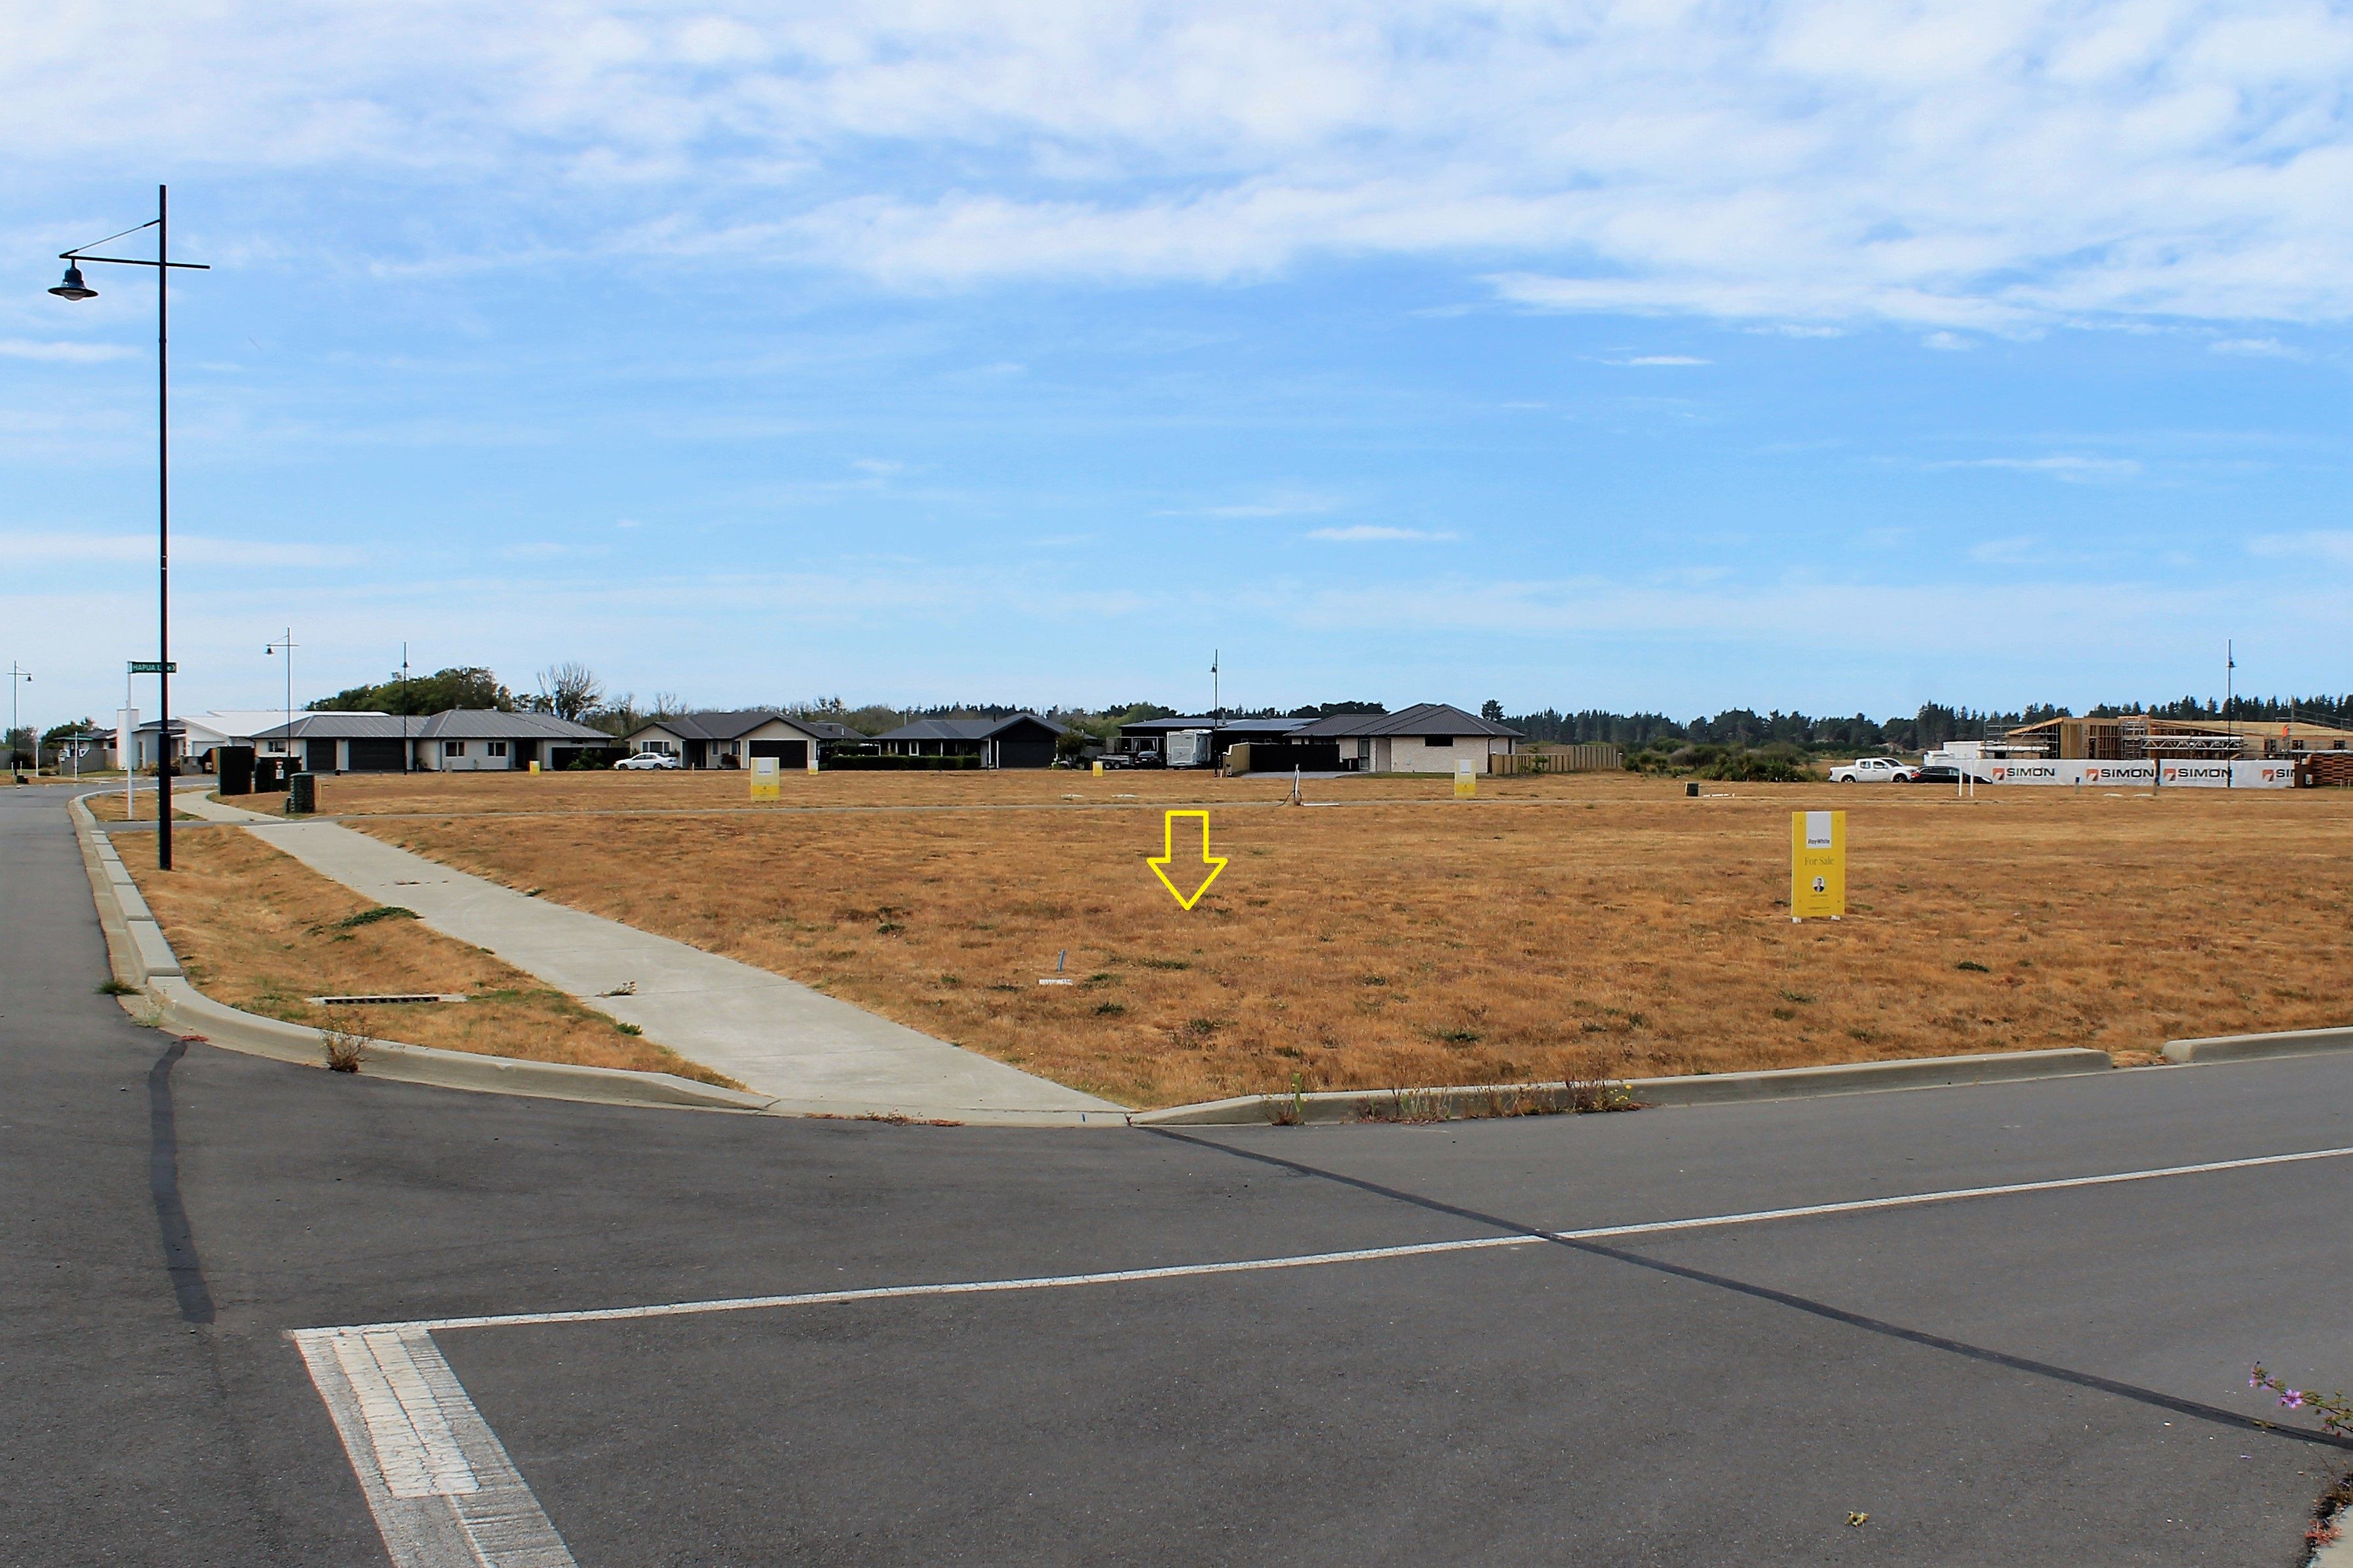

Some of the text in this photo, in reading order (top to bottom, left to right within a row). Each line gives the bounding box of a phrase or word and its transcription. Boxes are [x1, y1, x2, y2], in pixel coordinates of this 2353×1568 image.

[2006, 767, 2055, 776] SIMON
[2100, 768, 2154, 778] SIMON
[2177, 768, 2232, 778] SIMON
[1804, 855, 1834, 866] For Sale
